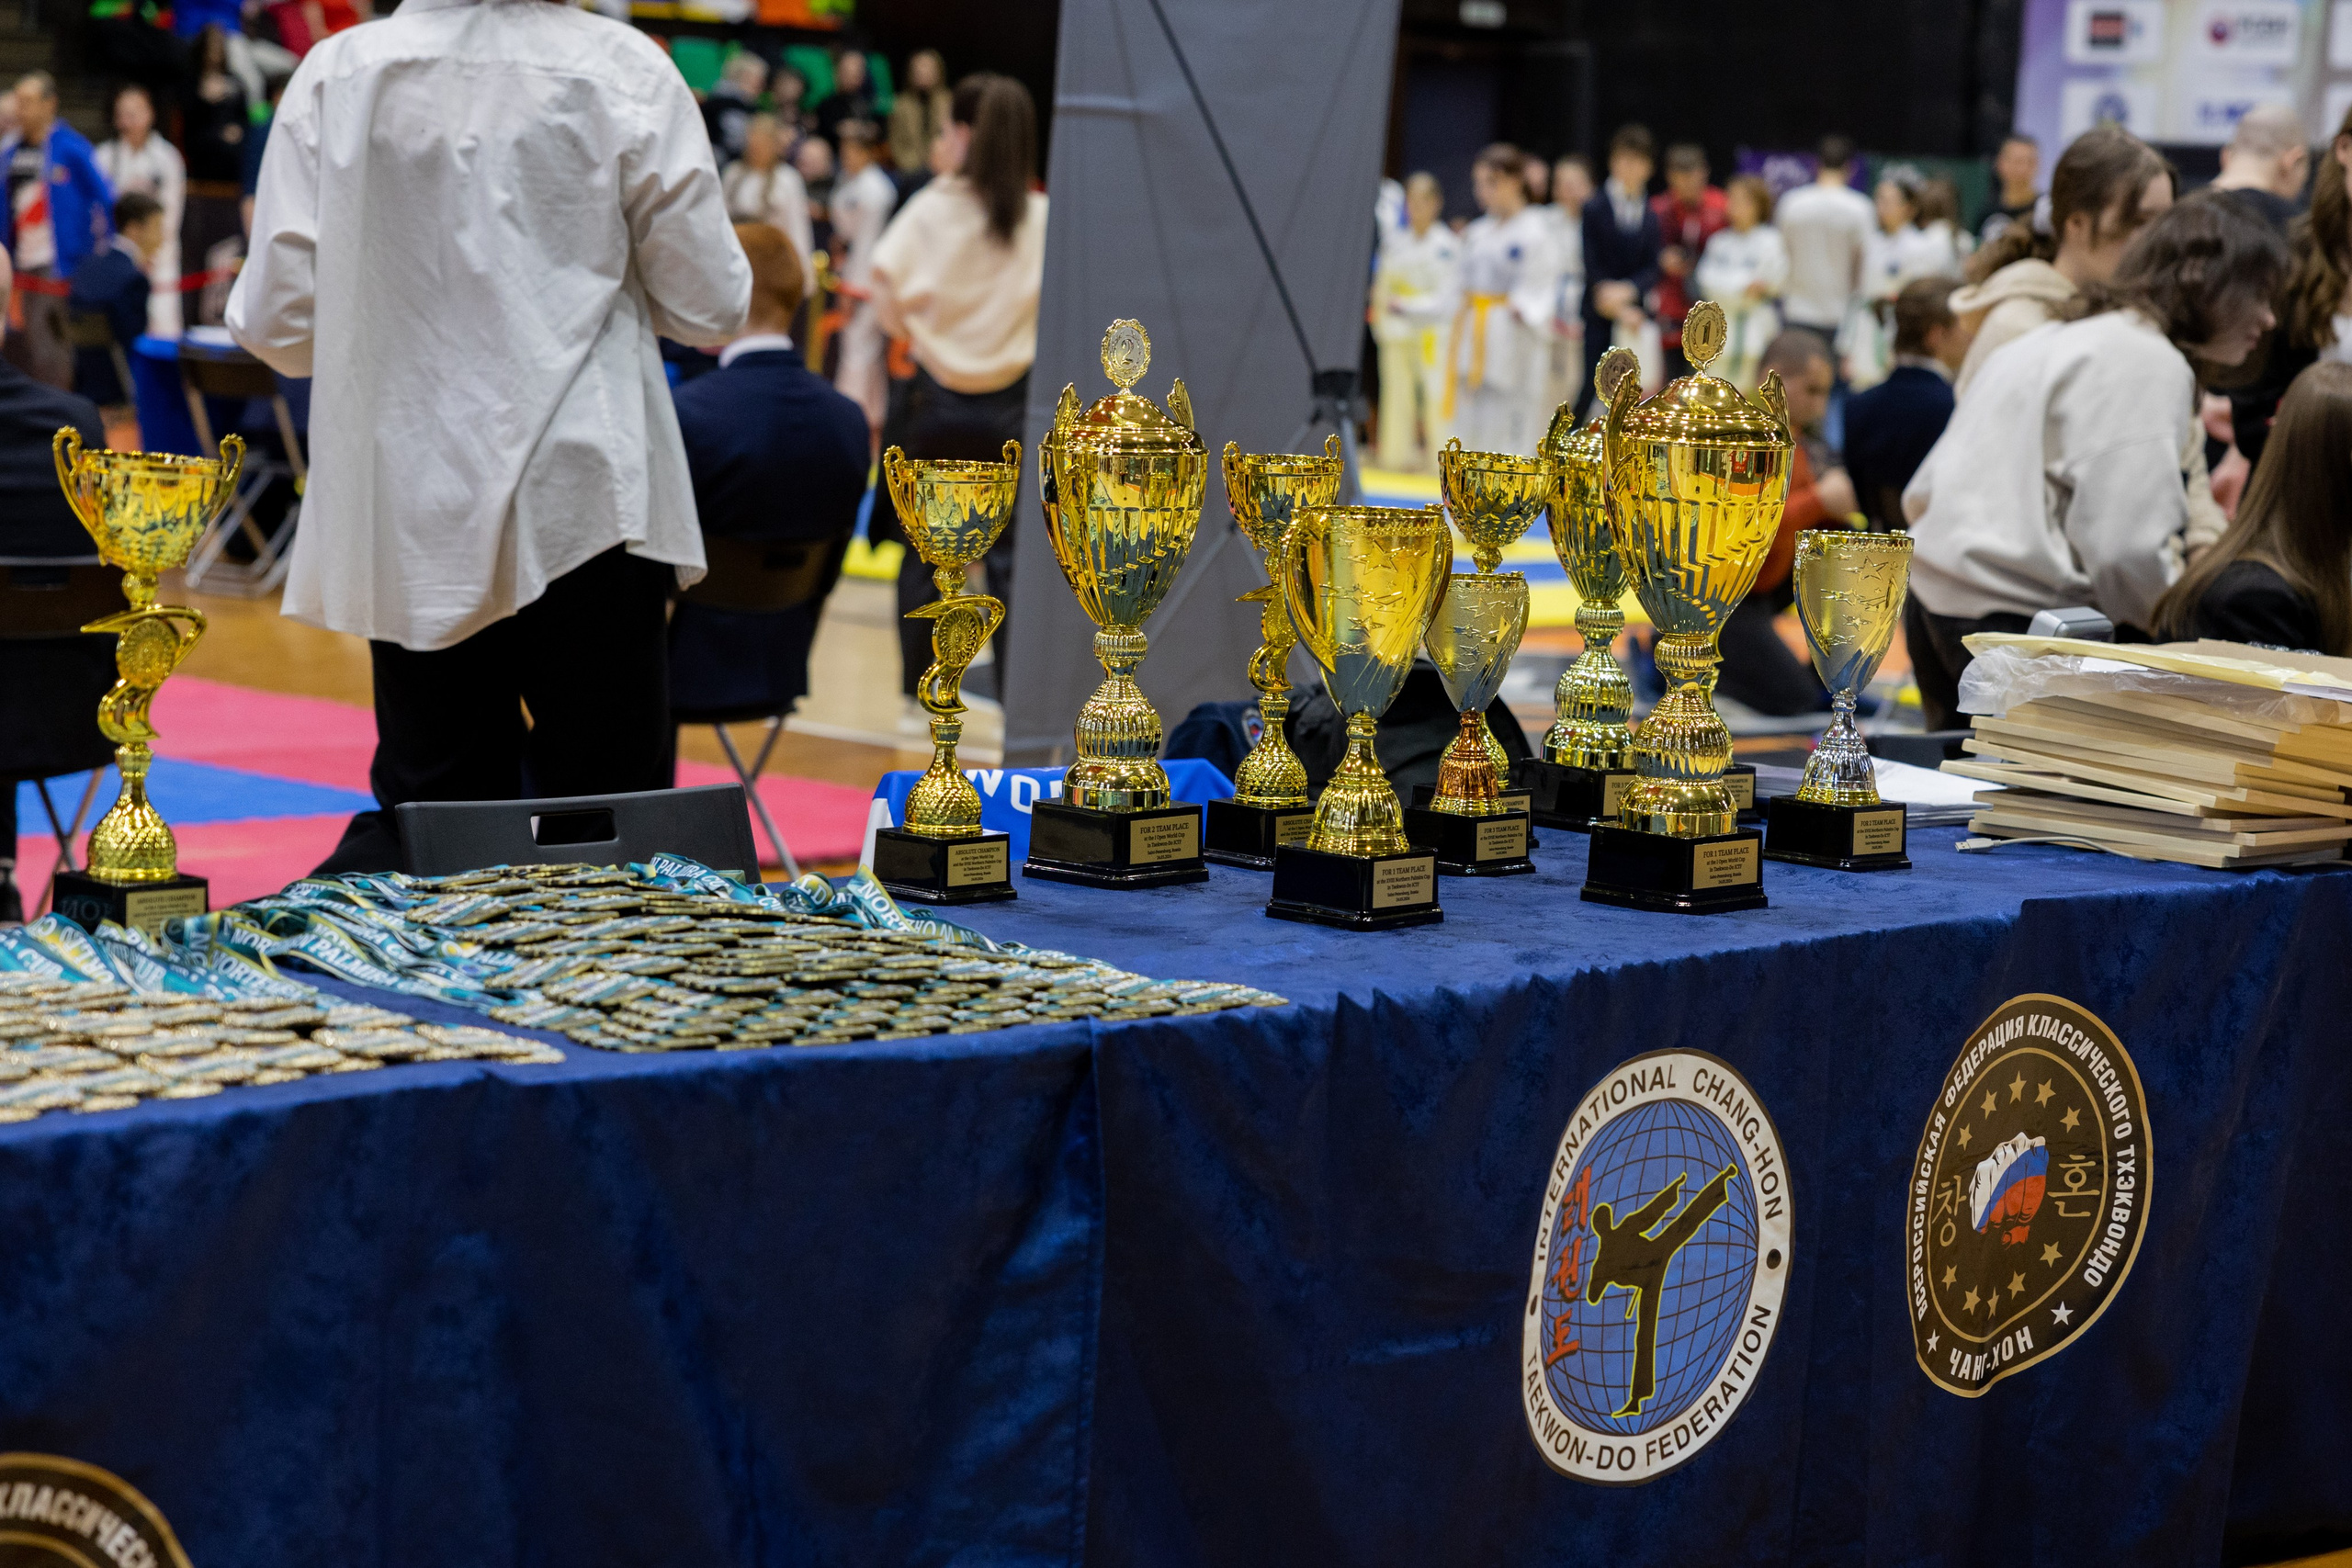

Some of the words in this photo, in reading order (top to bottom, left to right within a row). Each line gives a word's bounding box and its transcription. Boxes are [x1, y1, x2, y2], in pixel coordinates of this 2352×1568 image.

[1156, 824, 1171, 832] TEAM
[1172, 822, 1189, 830] PLACE
[1734, 847, 1749, 855] PLACE
[657, 859, 707, 878] PALMIRA
[1396, 866, 1409, 874] TEAM
[1538, 1064, 1677, 1261] INTERNATIONAL
[1692, 1067, 1783, 1221] CHANG-HON
[1913, 1111, 1946, 1322] ВСЕРОССИЙСКАЯ
[1945, 1015, 2024, 1108] ФЕДЕРАЦИЯ
[2027, 1014, 2132, 1140] КЛАССИЧЕСКОГО
[2083, 1145, 2136, 1287] ТХЭКВОНДО
[1932, 1175, 1967, 1247] 창
[2047, 1155, 2100, 1217] 혼
[1949, 1325, 2034, 1381] ЧАНГ-ХОН
[1527, 1347, 1636, 1471] TAEKWON-DO
[1645, 1304, 1772, 1466] FEDERATION
